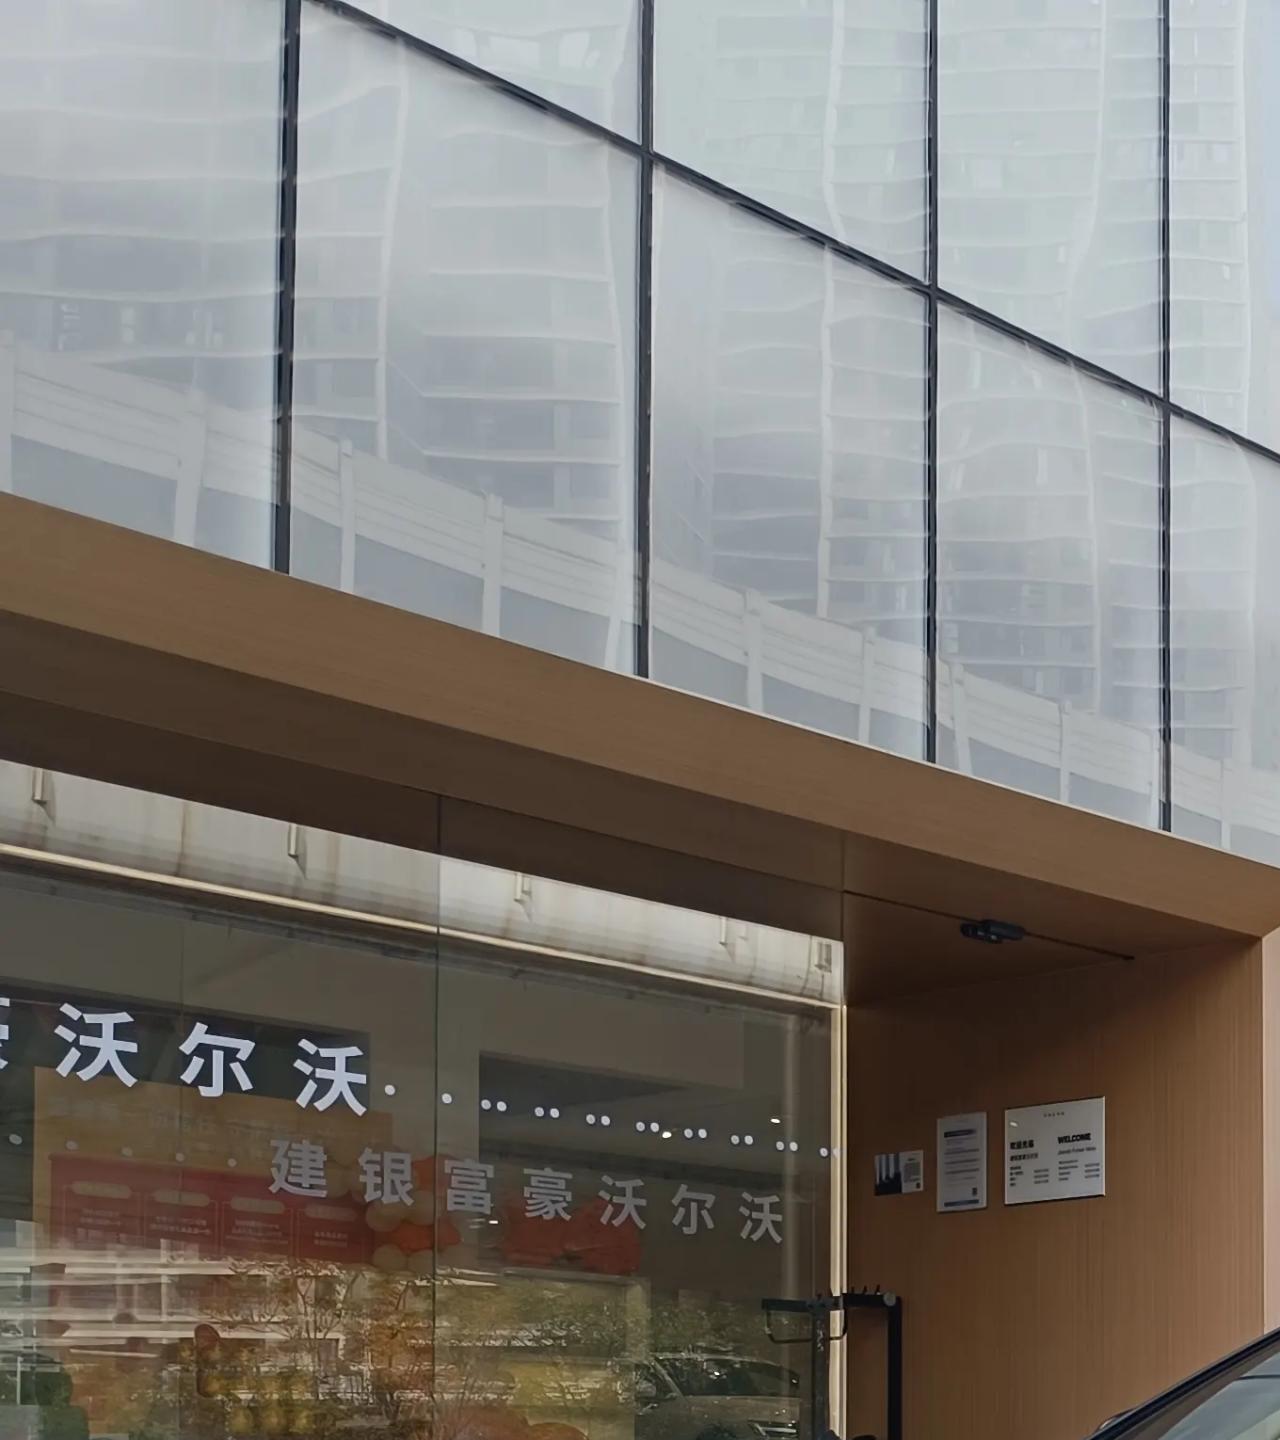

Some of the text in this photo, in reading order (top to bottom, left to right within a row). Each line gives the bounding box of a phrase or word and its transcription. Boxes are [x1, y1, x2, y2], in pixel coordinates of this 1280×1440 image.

[0, 996, 367, 1117] 沃尔沃
[1058, 1133, 1091, 1144] WELCOME
[268, 1140, 783, 1244] 建银富豪沃尔沃
